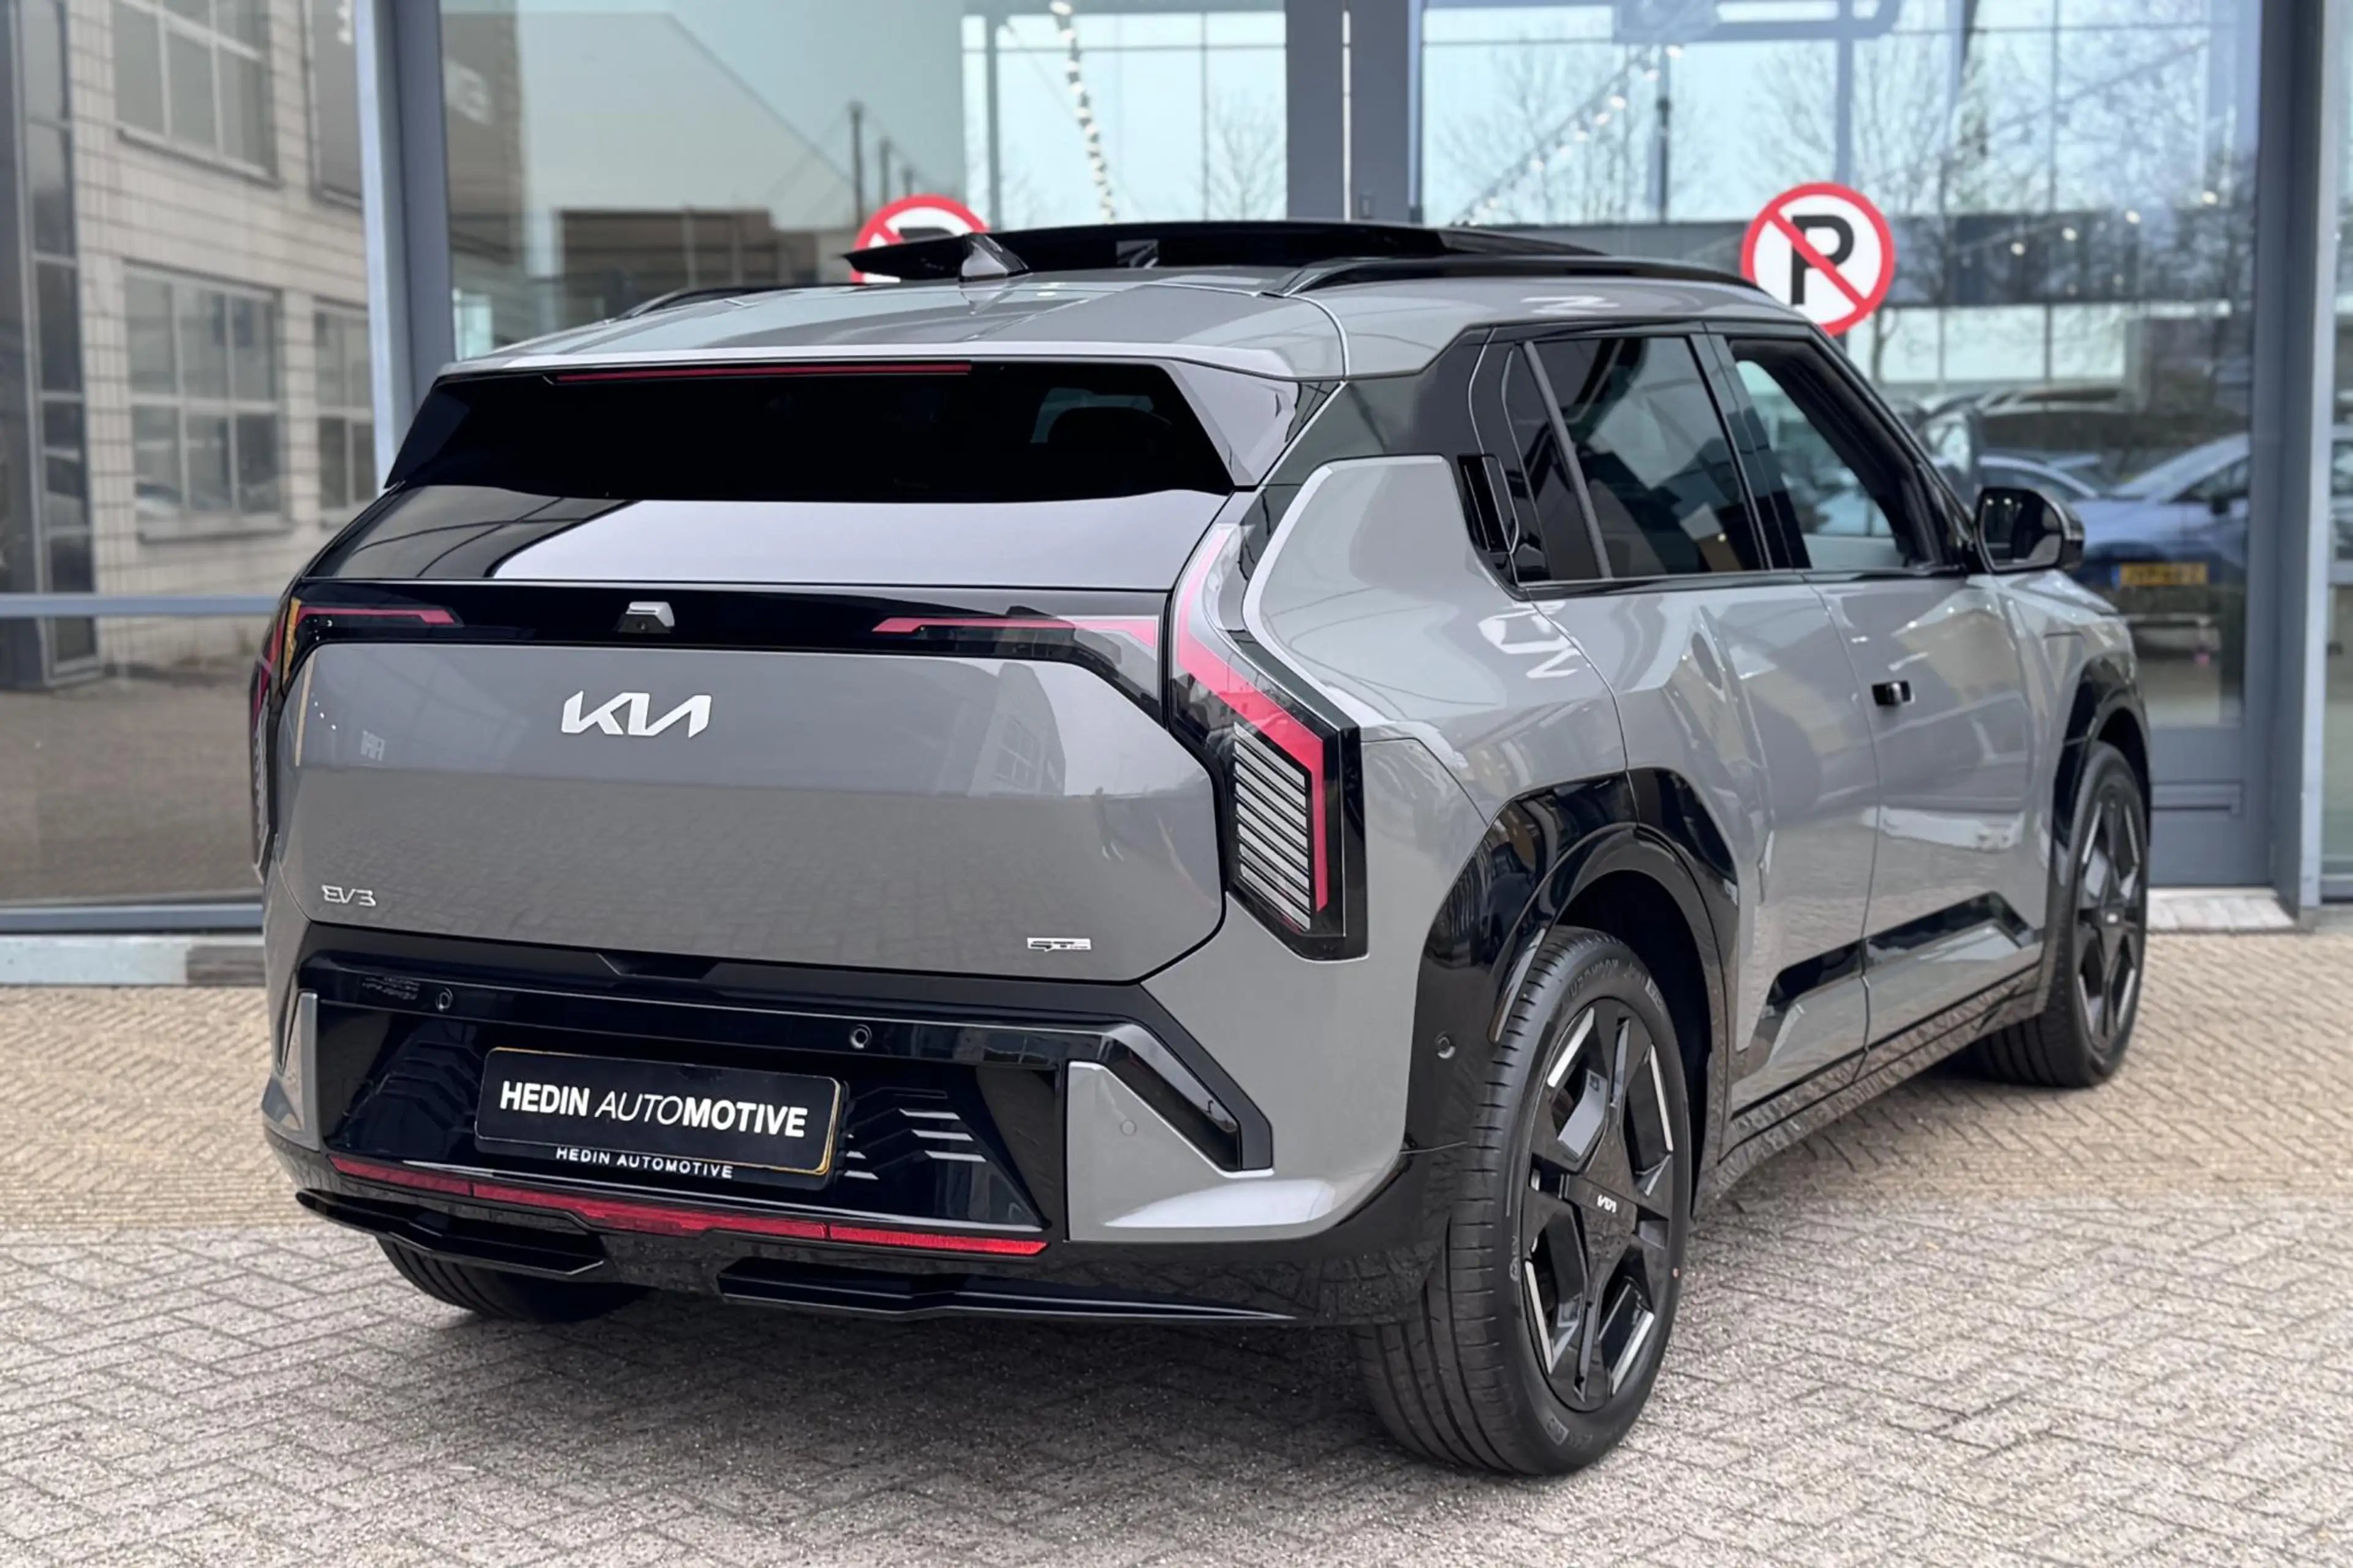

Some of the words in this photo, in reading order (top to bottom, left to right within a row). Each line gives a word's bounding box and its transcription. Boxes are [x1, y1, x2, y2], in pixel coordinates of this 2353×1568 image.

[321, 885, 376, 906] EV3
[499, 1080, 590, 1116] HEDIN
[594, 1091, 808, 1138] AUTOMOTIVE
[556, 1147, 610, 1165] HEDIN
[616, 1154, 733, 1179] AUTOMOTIVE
